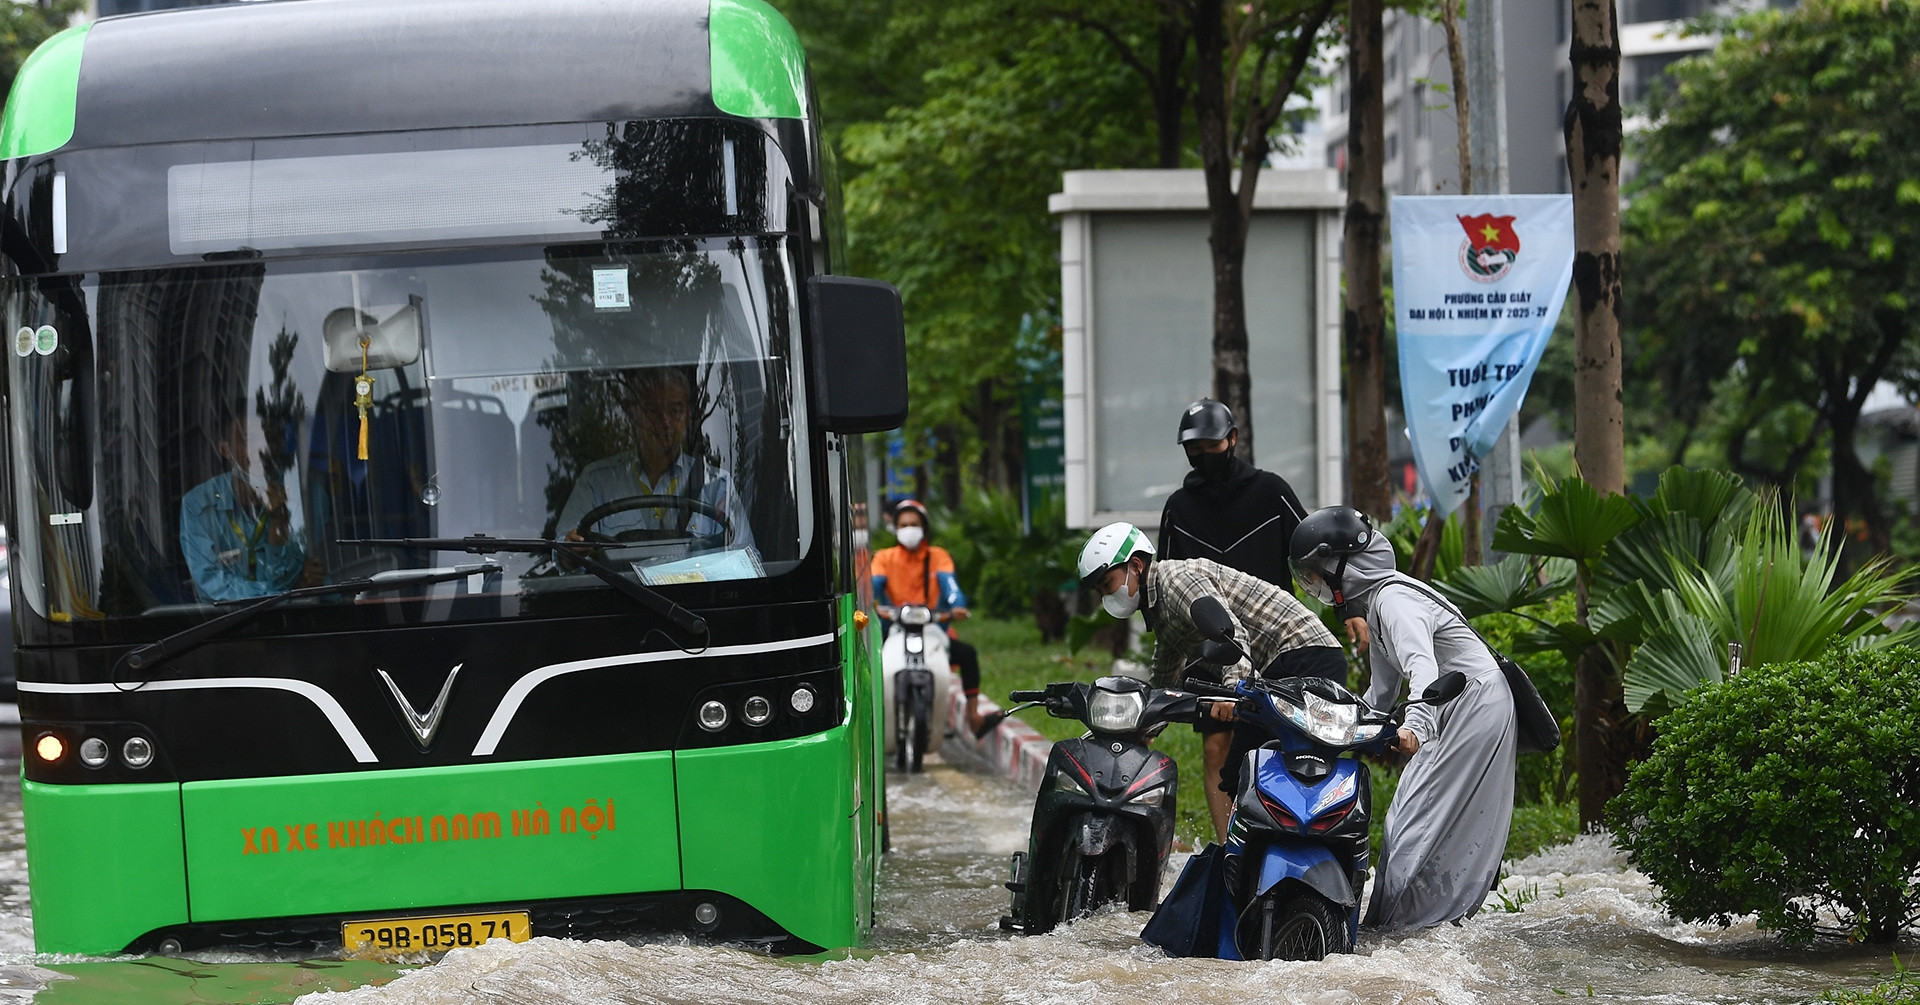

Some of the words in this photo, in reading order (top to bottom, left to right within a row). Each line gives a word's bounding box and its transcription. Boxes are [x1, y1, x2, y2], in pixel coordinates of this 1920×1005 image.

[1507, 307, 1530, 318] 2025
[1295, 755, 1326, 764] HONDA
[285, 823, 320, 852] XE
[327, 811, 425, 849] KHÁCH
[430, 811, 502, 842] NAM
[511, 800, 551, 837] HÀ
[560, 797, 616, 840] NỘI
